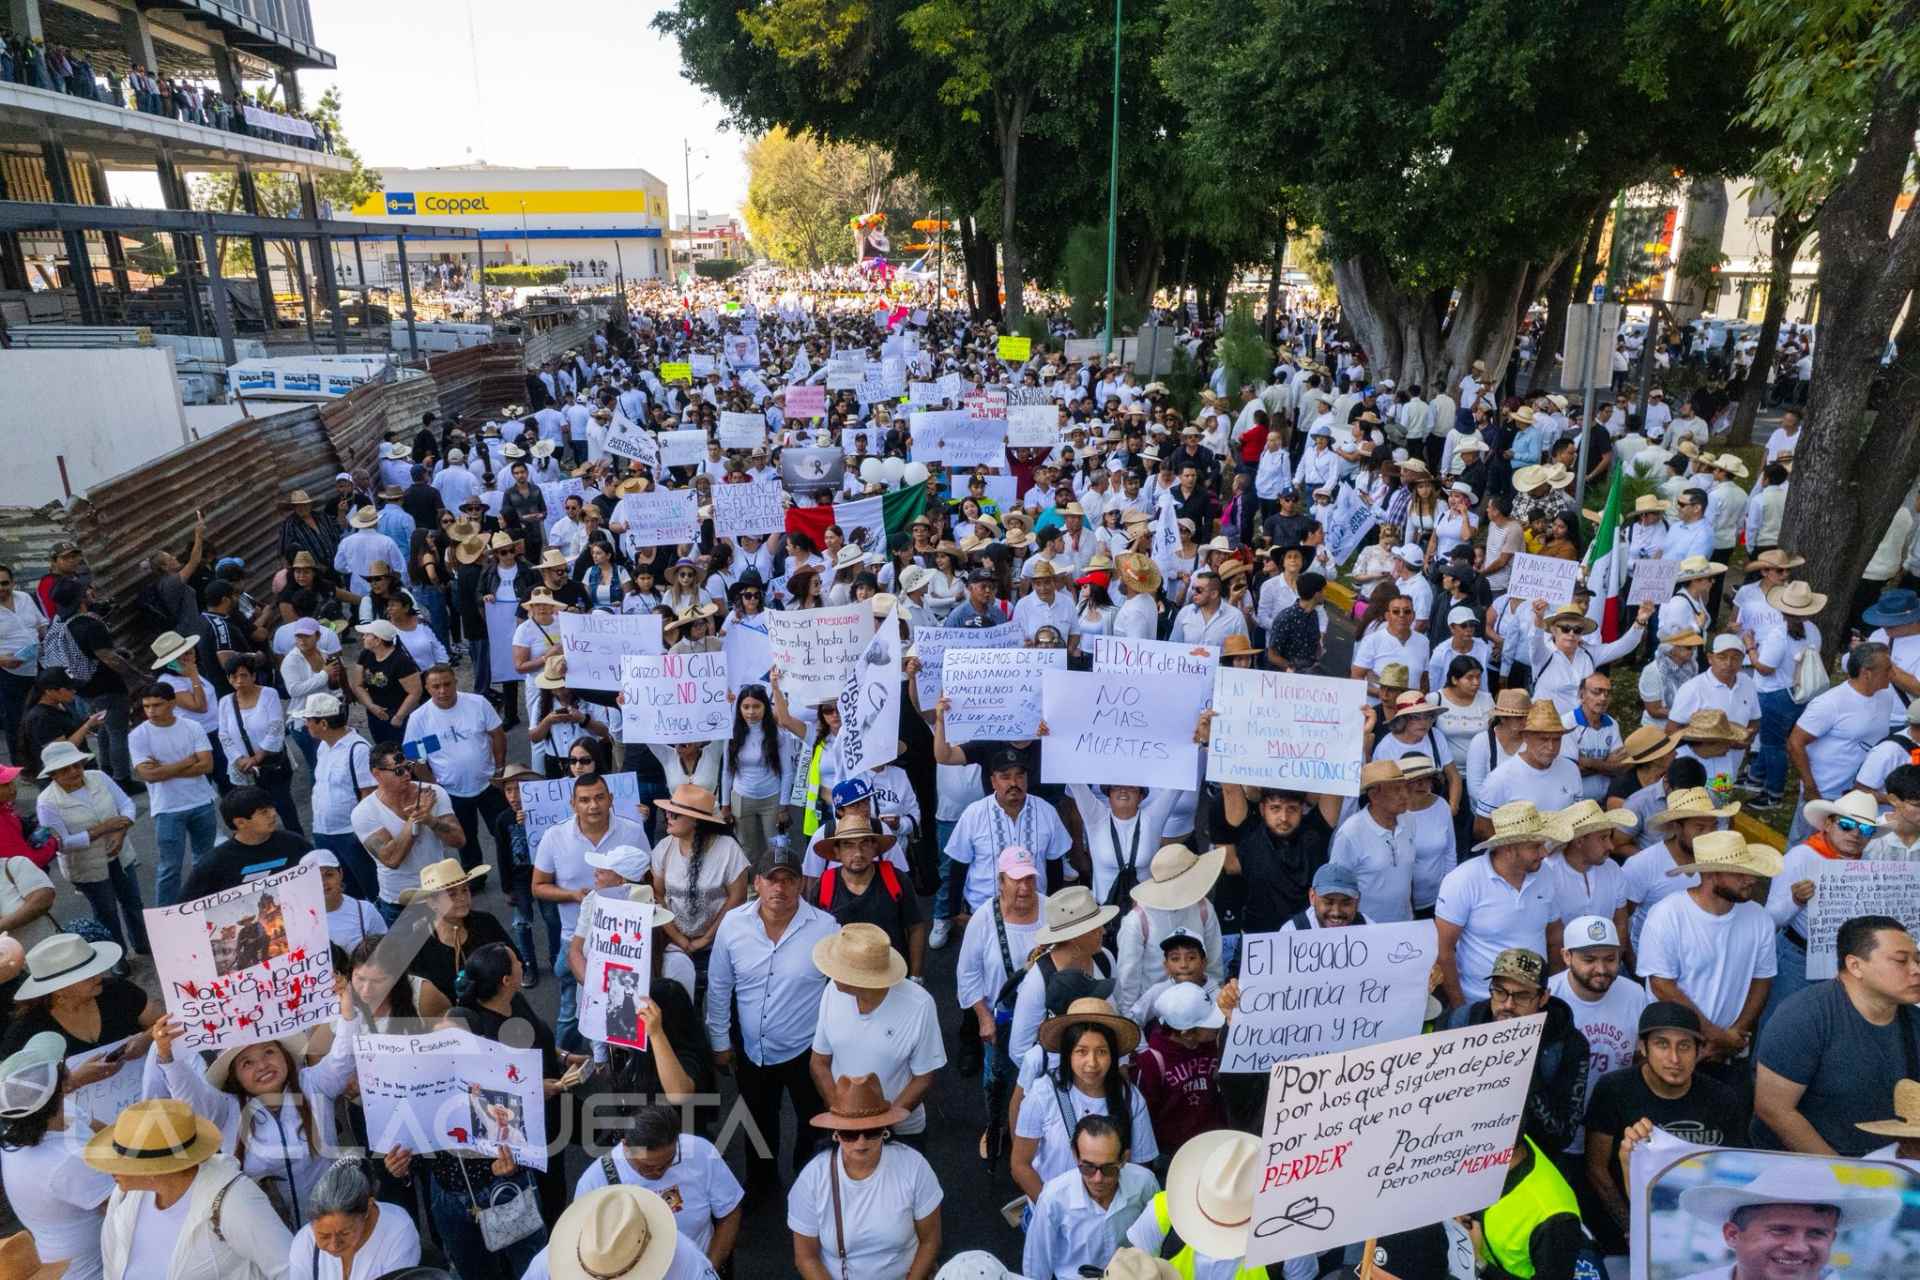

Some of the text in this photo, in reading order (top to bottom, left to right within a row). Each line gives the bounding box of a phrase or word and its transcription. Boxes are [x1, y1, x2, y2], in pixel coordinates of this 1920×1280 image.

[425, 196, 490, 215] Coppel
[794, 617, 812, 629] ser
[816, 630, 844, 647] hasta
[849, 629, 859, 644] la
[918, 630, 931, 642] YA
[934, 630, 965, 642] BASTA
[662, 655, 684, 678] NO
[687, 654, 726, 680] Calla
[801, 651, 817, 666] de
[822, 650, 834, 665] la
[946, 651, 1056, 666] SEGUIREMOS DE PIE
[1115, 639, 1156, 668] Dolor
[1157, 653, 1175, 673] de
[945, 669, 1033, 682] TRABAJANDO Y
[646, 686, 674, 706] Voz
[676, 682, 697, 705] NO
[702, 683, 725, 704] Se
[1096, 684, 1142, 706] NO
[1092, 706, 1149, 729] MAS
[1074, 731, 1171, 761] MUERTES
[1267, 738, 1328, 761] MANZO
[178, 864, 309, 916] Carlos Manzo
[624, 916, 643, 935] mi
[271, 949, 331, 985] para
[1247, 934, 1369, 977] El legado
[1359, 977, 1392, 1004] Por
[182, 998, 230, 1018] ser
[184, 1001, 342, 1049] ser historia
[377, 1041, 406, 1055] mejor
[1165, 1056, 1219, 1088] SUPER
[1335, 1055, 1376, 1087] los
[1380, 1050, 1422, 1089] que
[1425, 1040, 1455, 1070] ya
[1462, 1033, 1488, 1051] no
[1182, 1076, 1208, 1095] STAR
[1273, 1102, 1313, 1136] por
[1320, 1088, 1351, 1112] los
[1354, 1083, 1391, 1112] que
[1394, 1064, 1456, 1096] siguen
[1266, 1131, 1306, 1166] por
[1313, 1116, 1345, 1142] los
[1348, 1110, 1384, 1136] que
[1388, 1101, 1413, 1119] no
[1418, 1076, 1511, 1116] queremos
[1470, 1112, 1520, 1133] matar
[1366, 1165, 1382, 1179] a
[1384, 1156, 1406, 1177] el
[1376, 1171, 1419, 1199] pero
